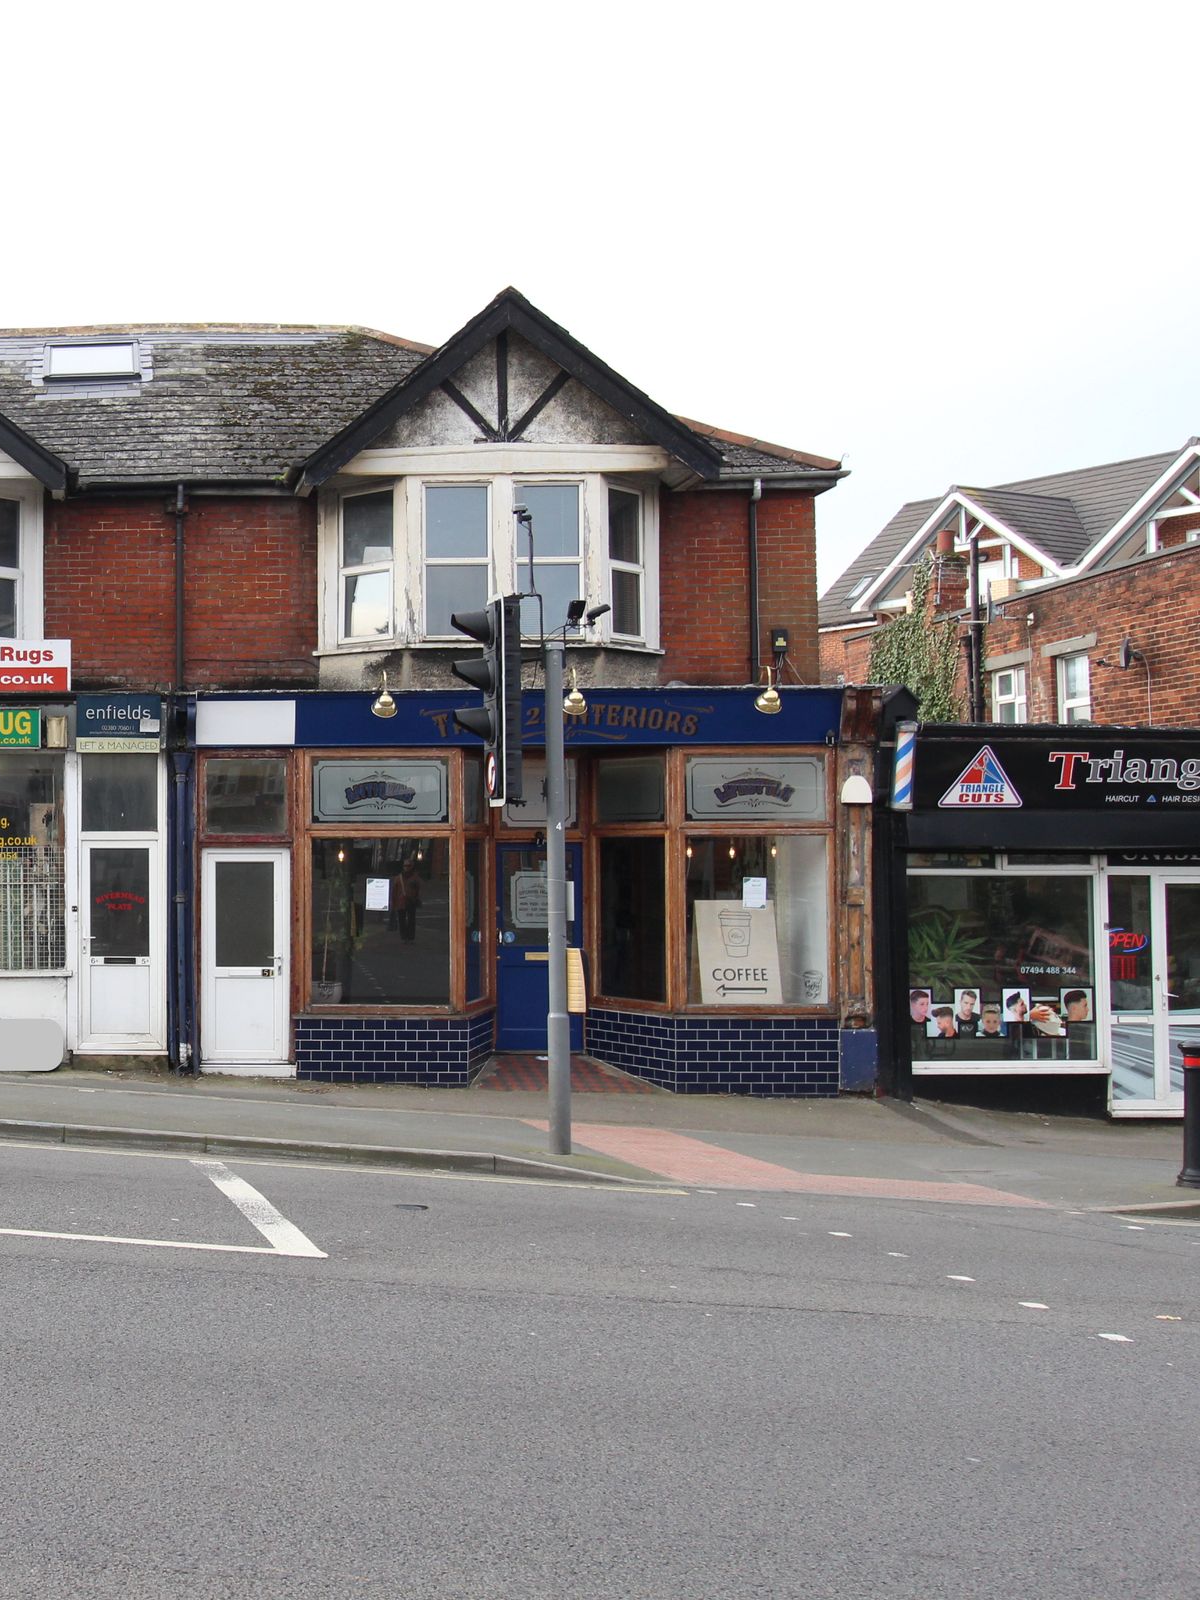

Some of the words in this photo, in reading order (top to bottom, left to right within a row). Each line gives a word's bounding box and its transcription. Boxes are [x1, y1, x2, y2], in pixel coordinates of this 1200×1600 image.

[0, 646, 54, 665] Rugs
[85, 704, 152, 720] enfields
[80, 741, 96, 750] LET
[107, 741, 158, 750] MANAGED
[1048, 749, 1200, 791] Triang
[960, 784, 1005, 793] TRIANGLE
[959, 793, 1005, 803] CUTS
[1105, 795, 1140, 803] HAIRCUT
[1161, 795, 1181, 803] HAIR
[555, 822, 562, 832] 4
[1109, 933, 1144, 948] OPEN
[712, 968, 769, 982] COFFEE
[1020, 966, 1044, 975] 07494
[1046, 966, 1060, 975] 488
[1062, 966, 1077, 975] 344
